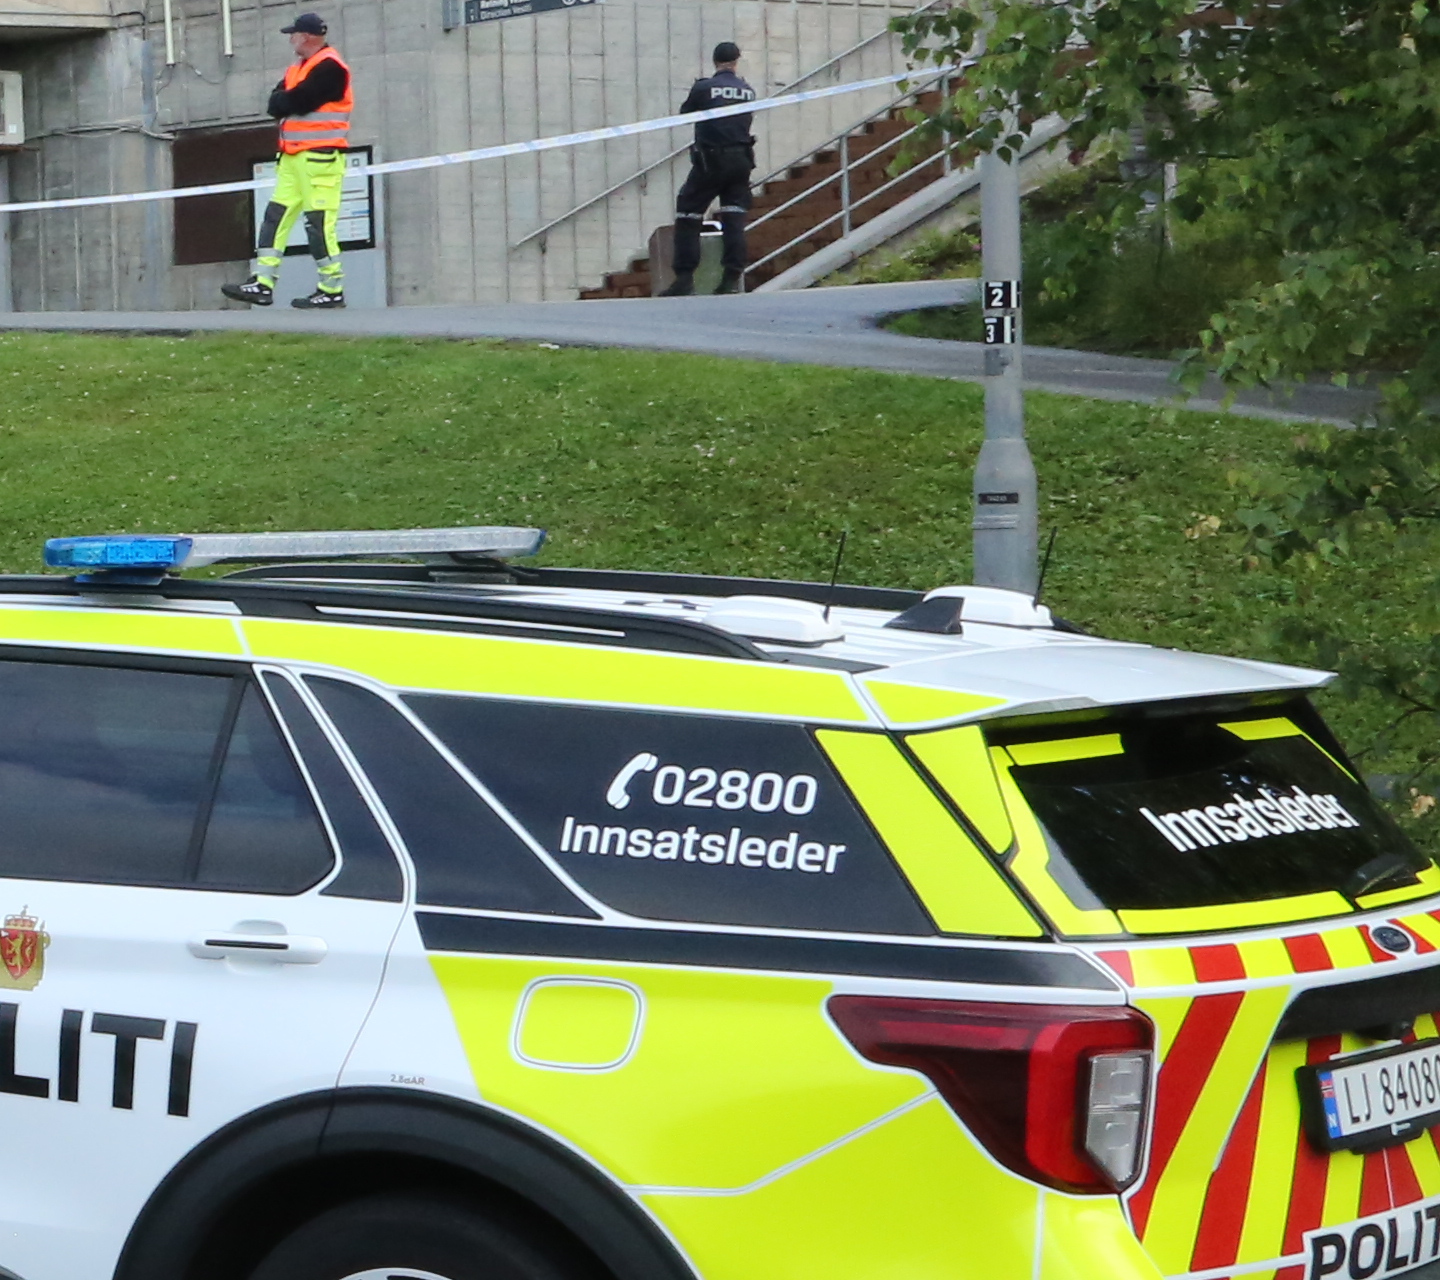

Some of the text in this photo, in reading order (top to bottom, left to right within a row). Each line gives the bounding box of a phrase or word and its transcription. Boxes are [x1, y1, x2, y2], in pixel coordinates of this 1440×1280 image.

[990, 287, 1004, 307] 2
[985, 324, 996, 343] 3
[651, 764, 819, 816] 02800
[559, 815, 847, 875] Innsatsleder
[1137, 784, 1361, 854] Innsatsleder
[1342, 1071, 1372, 1125] LJ
